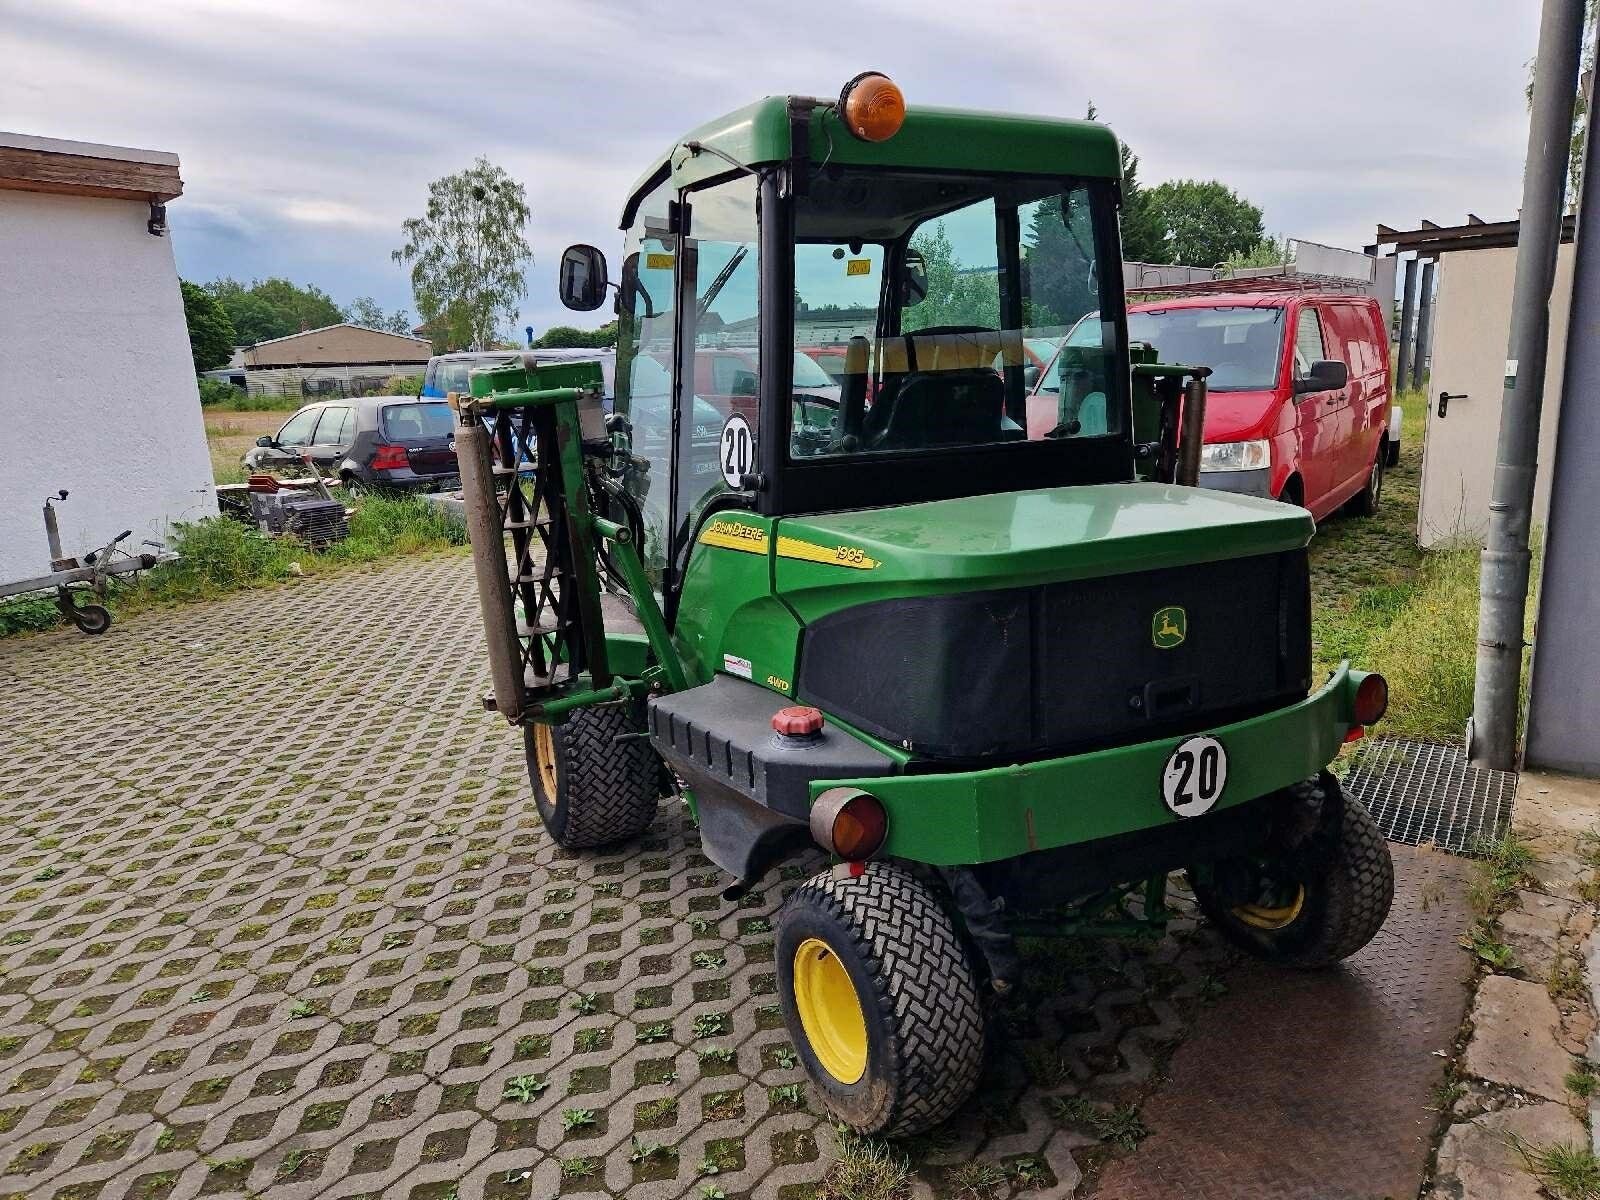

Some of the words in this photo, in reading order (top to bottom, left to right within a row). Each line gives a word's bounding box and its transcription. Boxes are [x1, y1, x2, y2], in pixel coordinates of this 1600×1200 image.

[726, 428, 746, 475] 20
[709, 519, 733, 535] JOHN
[733, 522, 764, 541] DEERE
[836, 545, 864, 563] 1905
[767, 675, 789, 691] 4WD
[1174, 746, 1218, 806] 20
